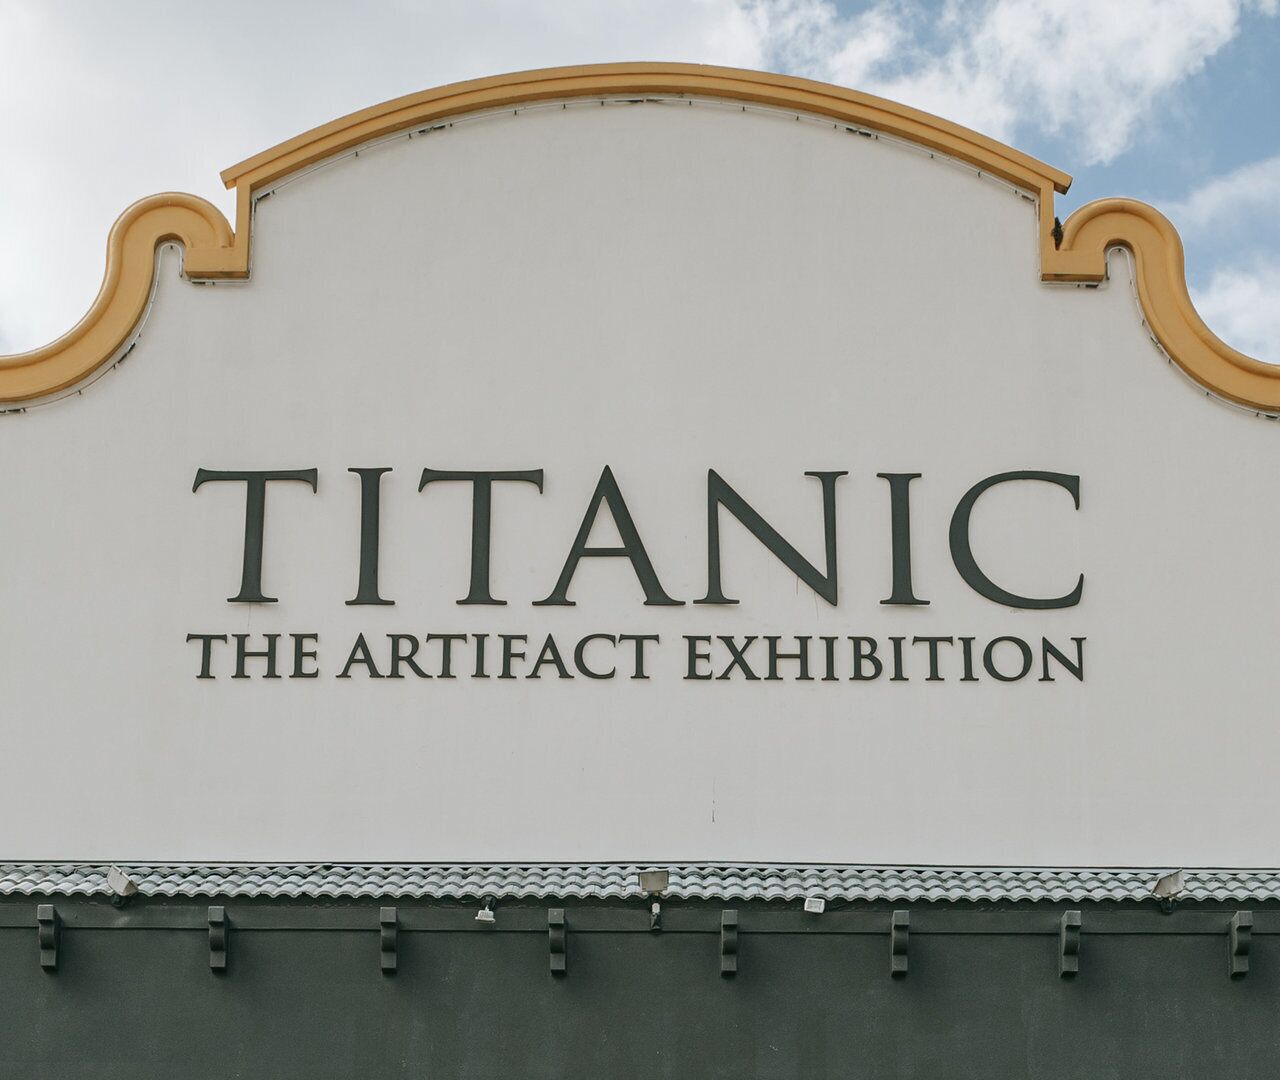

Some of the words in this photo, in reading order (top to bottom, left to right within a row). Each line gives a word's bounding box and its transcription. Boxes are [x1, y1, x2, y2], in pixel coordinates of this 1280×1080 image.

[191, 464, 1085, 610] TITANIC
[186, 633, 319, 680] THE
[335, 632, 660, 681] ARTIFACT
[683, 633, 1088, 682] EXHIBITION
